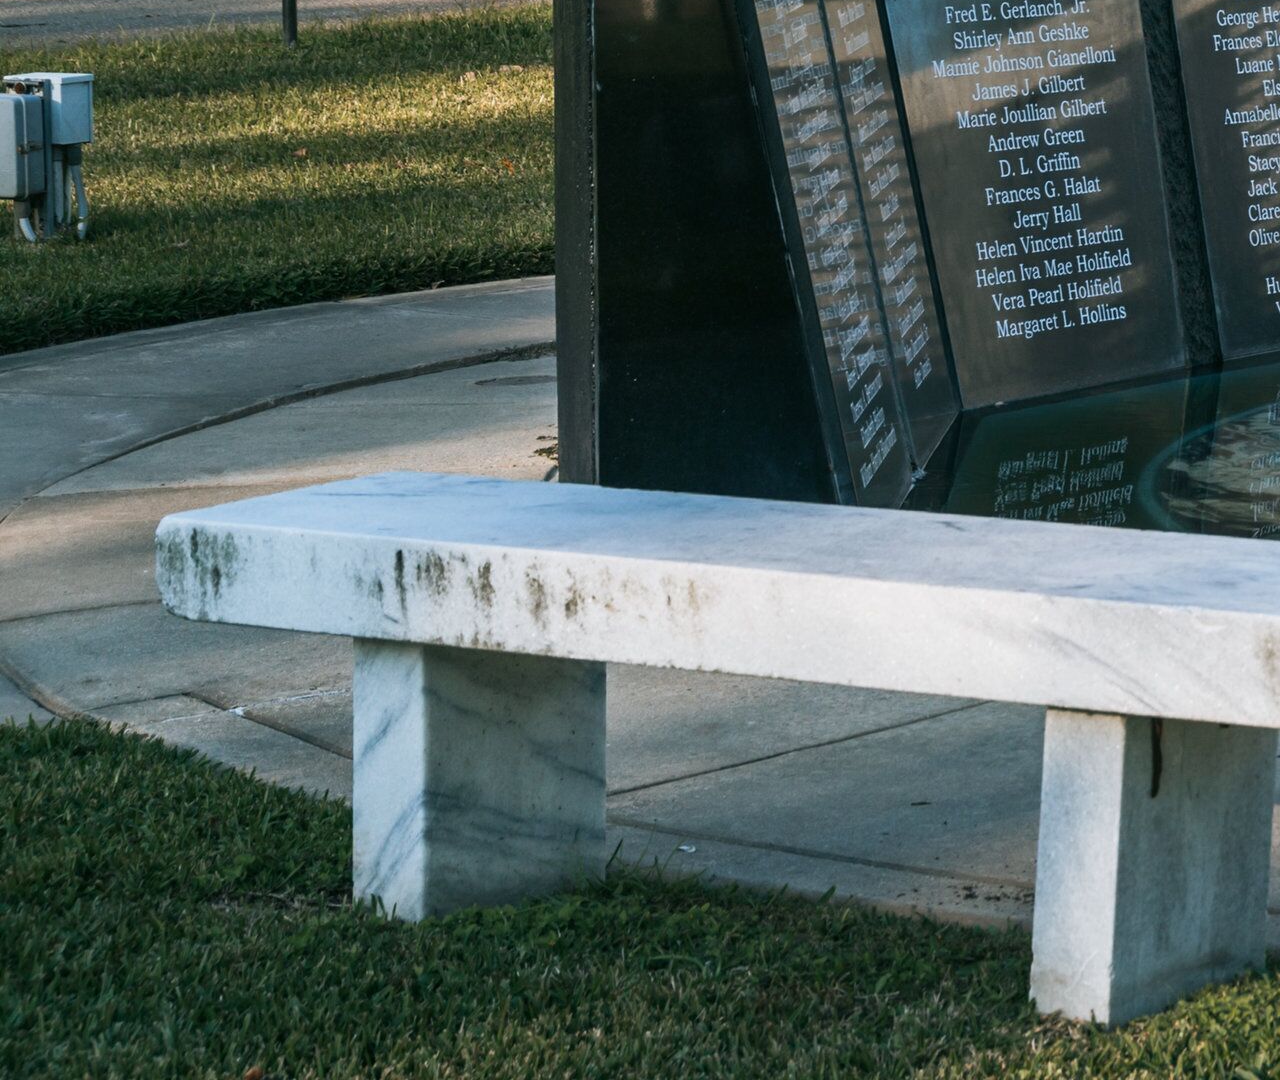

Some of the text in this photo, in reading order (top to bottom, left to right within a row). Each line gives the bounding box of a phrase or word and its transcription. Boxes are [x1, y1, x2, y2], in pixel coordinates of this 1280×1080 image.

[932, 45, 1116, 78] Mamie Johnson Gianelloni
[988, 128, 1085, 152] Andrew Green
[1248, 178, 1278, 197] Jack
[996, 304, 1127, 339] Margaret L. Hollins
